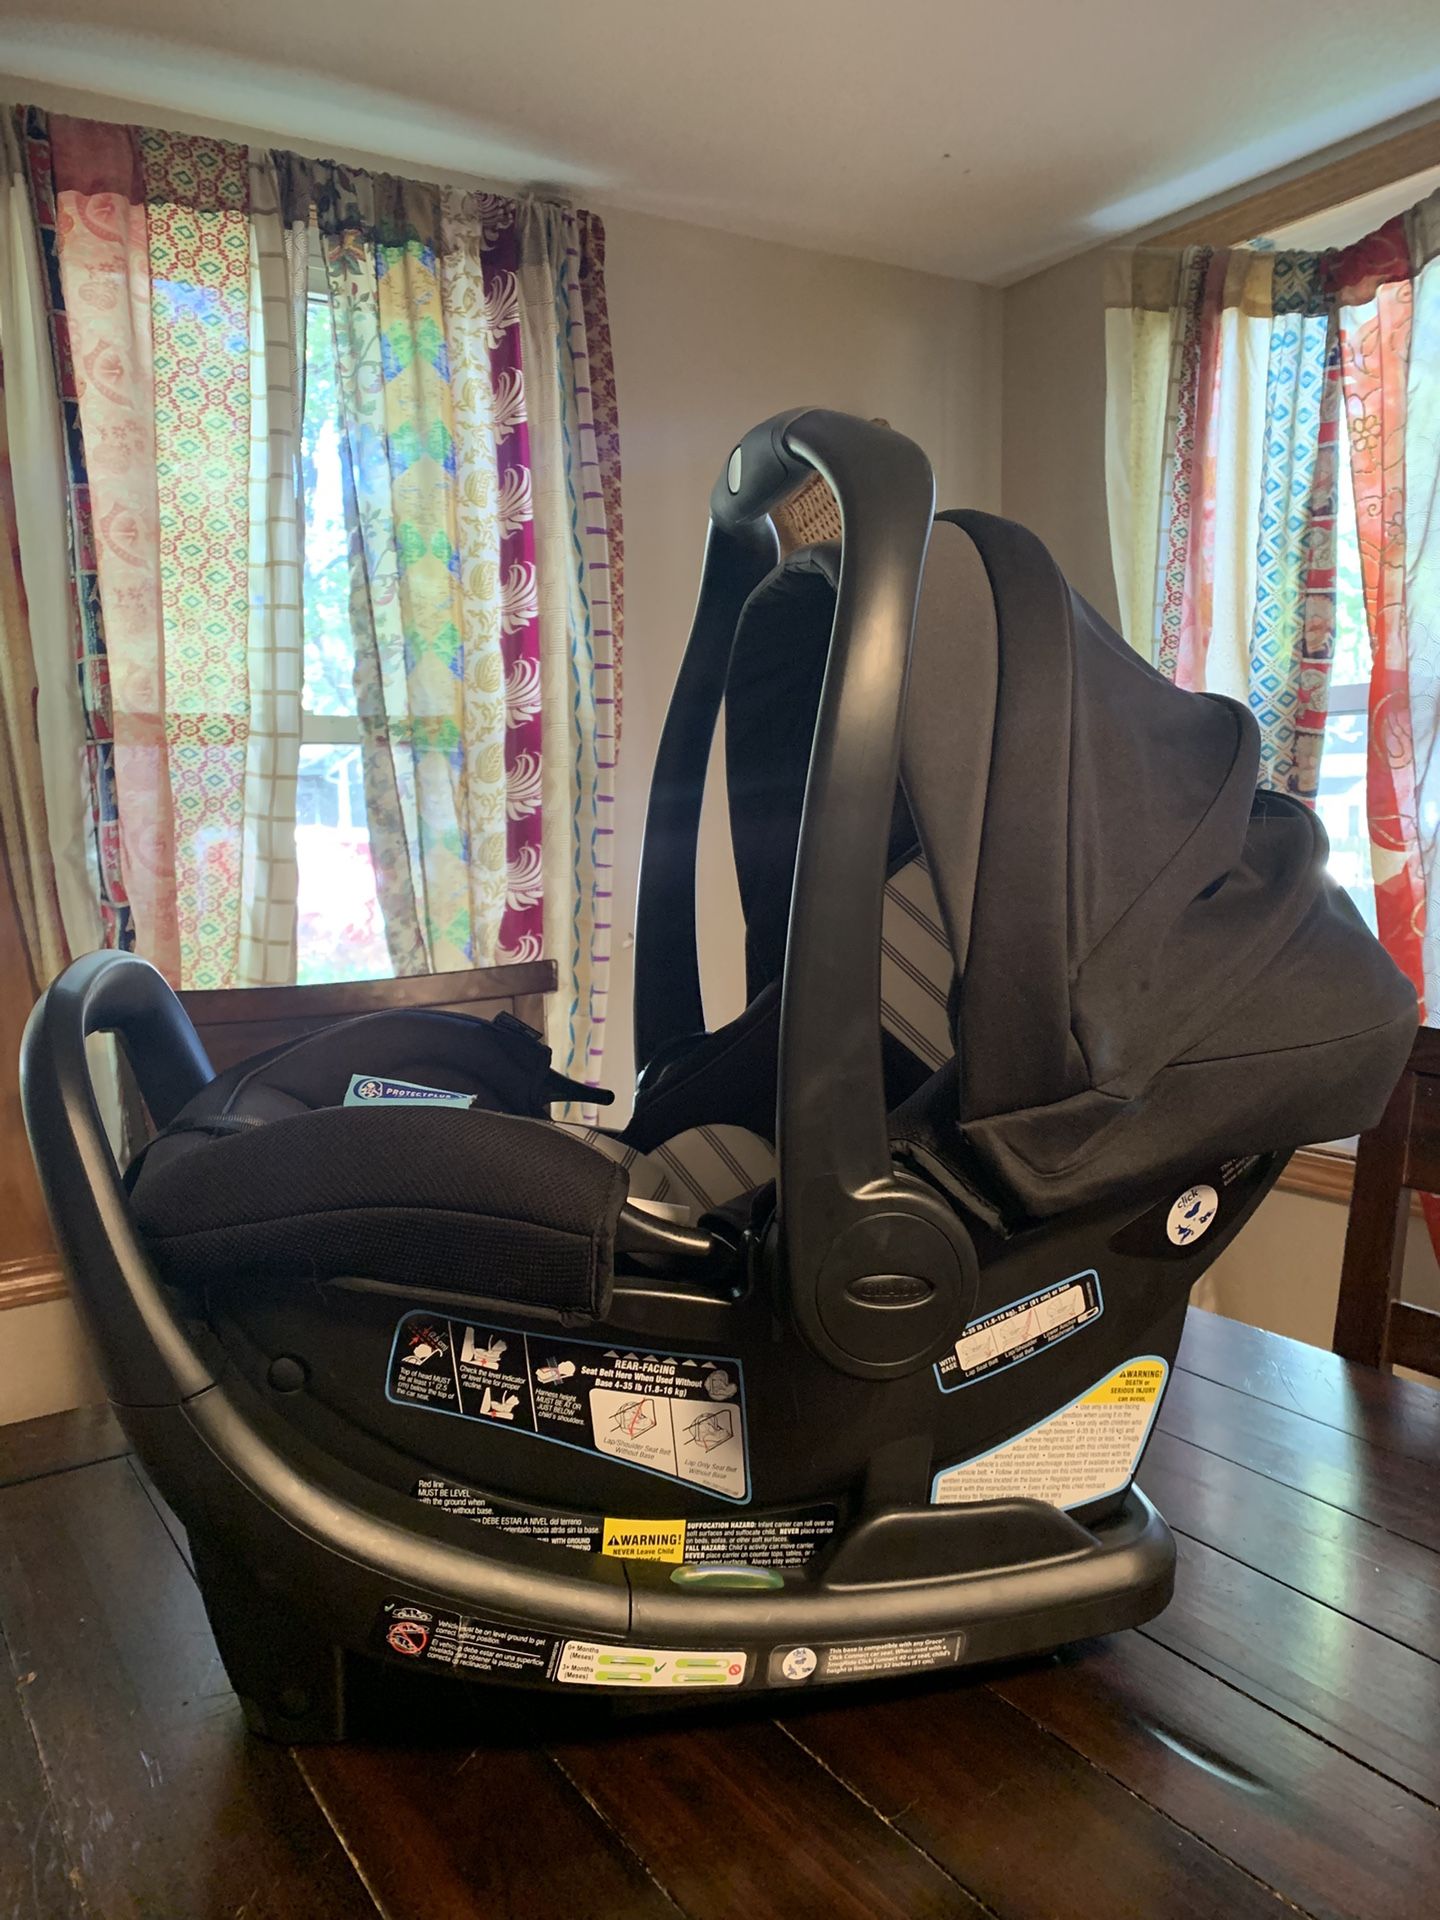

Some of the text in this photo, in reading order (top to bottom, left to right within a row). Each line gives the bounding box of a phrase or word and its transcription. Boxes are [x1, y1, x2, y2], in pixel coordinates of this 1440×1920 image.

[1177, 1189, 1199, 1208] click
[614, 1359, 676, 1375] REAR-FACING
[581, 1365, 703, 1388] Seat Belt Here When Used Without
[1126, 1370, 1163, 1379] WARNING!
[595, 1378, 688, 1398] Base 4-35 lb (1.8-16 kg)
[418, 1479, 445, 1489] Red line
[418, 1488, 471, 1499] MUST BE LEVEL
[432, 1498, 486, 1508] the ground when
[482, 1517, 500, 1525] DEBE
[501, 1517, 523, 1526] ESTAR
[523, 1517, 530, 1525] A
[529, 1517, 549, 1526] NIVEL
[549, 1517, 559, 1526] del
[687, 1521, 730, 1530] SUFFOCATION
[779, 1527, 800, 1536] NEVER
[620, 1534, 682, 1546] WARNING!
[613, 1548, 635, 1556] NEVER
[657, 1547, 676, 1555] Child
[685, 1544, 700, 1552] FALL
[684, 1552, 705, 1560] NEVER
[577, 1644, 599, 1654] Months
[570, 1651, 594, 1661] (Meses)
[562, 1663, 594, 1673] 3+ Months
[564, 1671, 589, 1681] (Meses)
